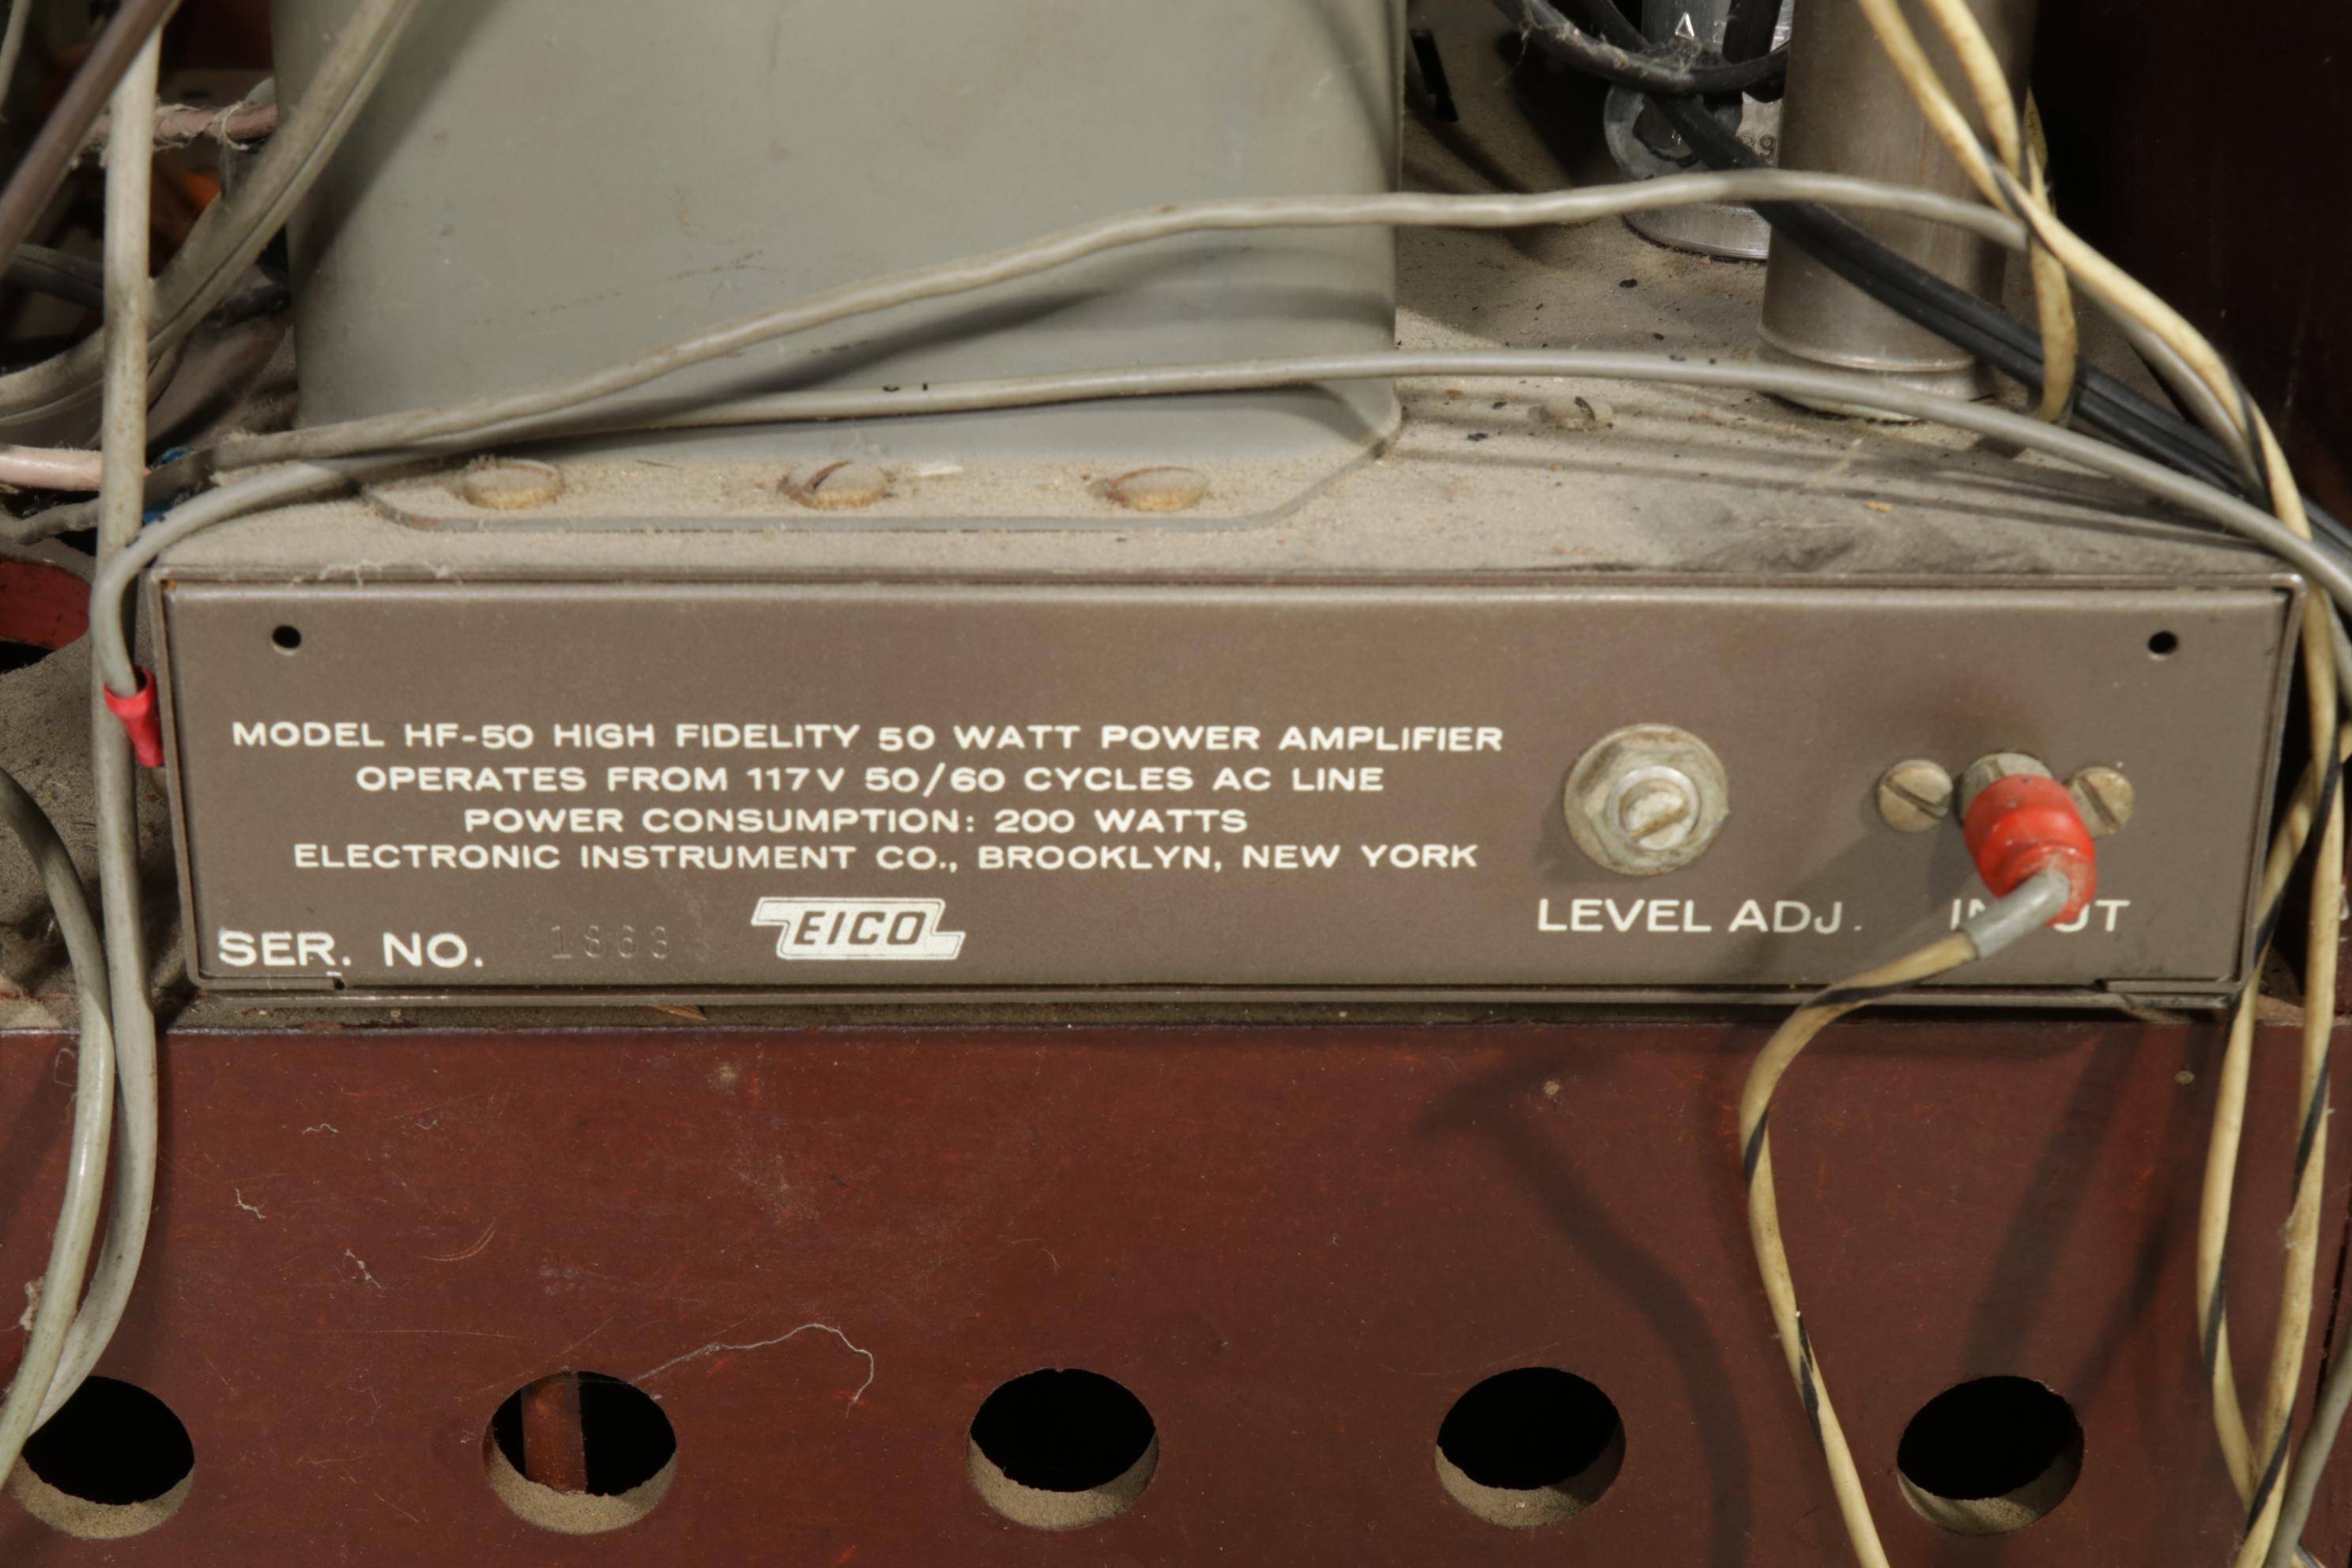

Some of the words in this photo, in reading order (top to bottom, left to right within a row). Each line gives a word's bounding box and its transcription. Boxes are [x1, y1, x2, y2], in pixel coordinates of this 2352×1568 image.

[232, 721, 385, 748] MODEL
[405, 722, 534, 749] HF-50
[553, 722, 655, 749] HIGH
[676, 723, 860, 748] FIDELITY
[878, 724, 935, 752] 50
[953, 725, 1081, 750] WATT
[1101, 725, 1261, 751] POWER
[1278, 726, 1503, 752] AMPLIFIER
[356, 766, 587, 792] OPERATES
[607, 766, 728, 792] FROM
[747, 767, 845, 792] 117V
[865, 762, 1005, 797] 50/60
[1023, 766, 1194, 792] CYCLES
[1212, 767, 1272, 792] AC
[1292, 767, 1384, 792] LINE
[464, 808, 624, 833] POWER
[642, 808, 974, 834] CONSUMPTION:
[994, 808, 1076, 834] 200
[1094, 808, 1248, 834] WATTS
[294, 843, 560, 869] ELECTRONIC
[581, 845, 857, 869] INSTRUMENT
[876, 846, 957, 872] CO.,
[978, 845, 1222, 872] BROOKLYN,
[1242, 844, 1340, 869] NEW
[1361, 843, 1478, 869] YORK
[793, 910, 926, 945] EICO
[1537, 898, 1712, 933] LEVEL
[1728, 899, 1863, 934] ADJ.
[218, 929, 352, 967] SER.
[383, 932, 484, 968] NO.
